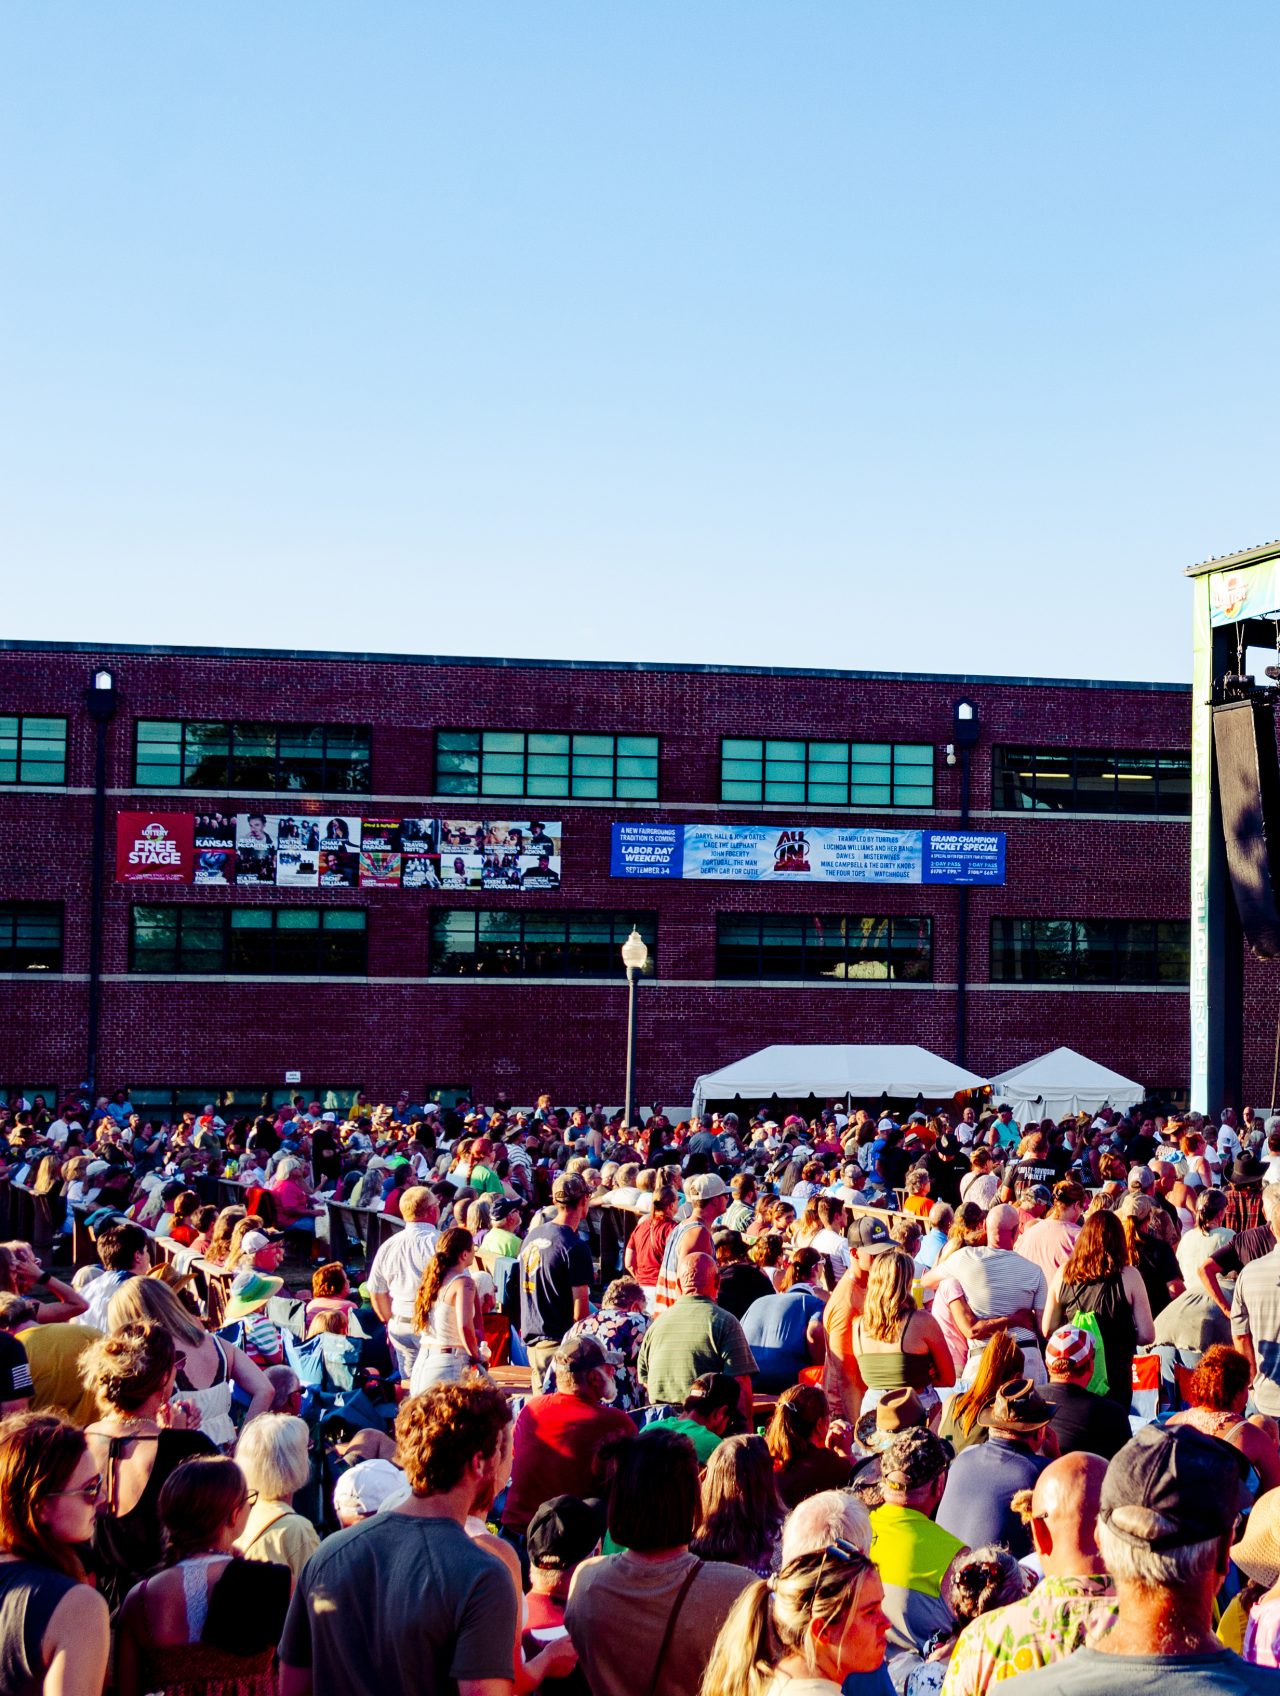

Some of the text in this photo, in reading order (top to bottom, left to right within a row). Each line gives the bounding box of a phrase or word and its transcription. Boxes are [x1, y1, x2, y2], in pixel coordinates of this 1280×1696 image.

[134, 840, 176, 852] FREE
[195, 839, 233, 848] KANSAS
[930, 843, 998, 851] TICKET SPECIAL
[621, 846, 674, 855] LABOR DAY
[129, 852, 181, 864] STAGE
[625, 854, 670, 863] WEEKEND
[625, 866, 660, 874] SEPTEMBER
